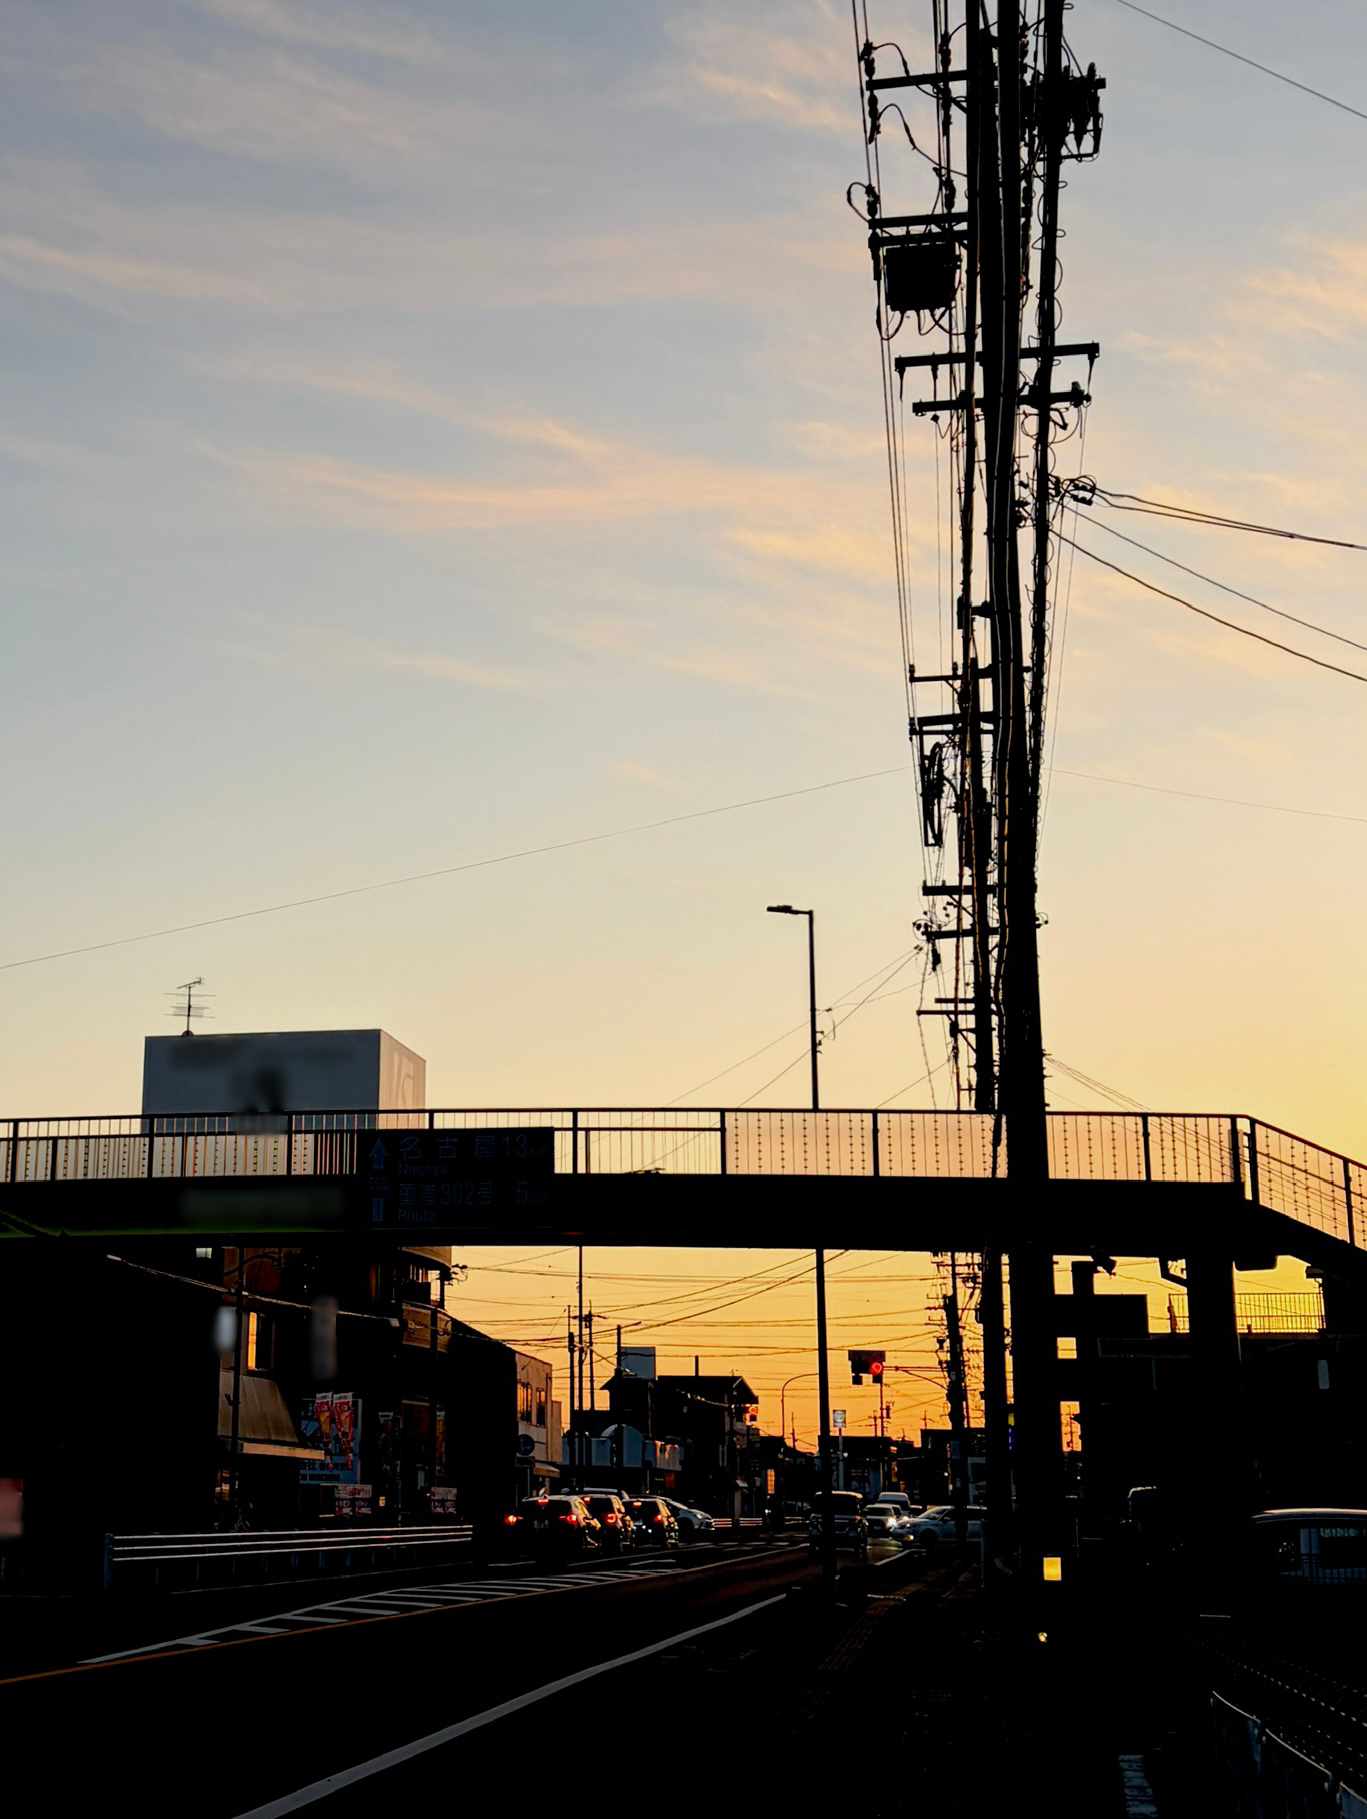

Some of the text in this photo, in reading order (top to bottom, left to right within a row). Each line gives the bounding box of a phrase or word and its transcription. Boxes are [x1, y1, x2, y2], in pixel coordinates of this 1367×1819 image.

[399, 1136, 496, 1159] 名古屋
[398, 1162, 448, 1176] Nagoya
[399, 1182, 494, 1206] 国道302号
[397, 1209, 436, 1222] Route
